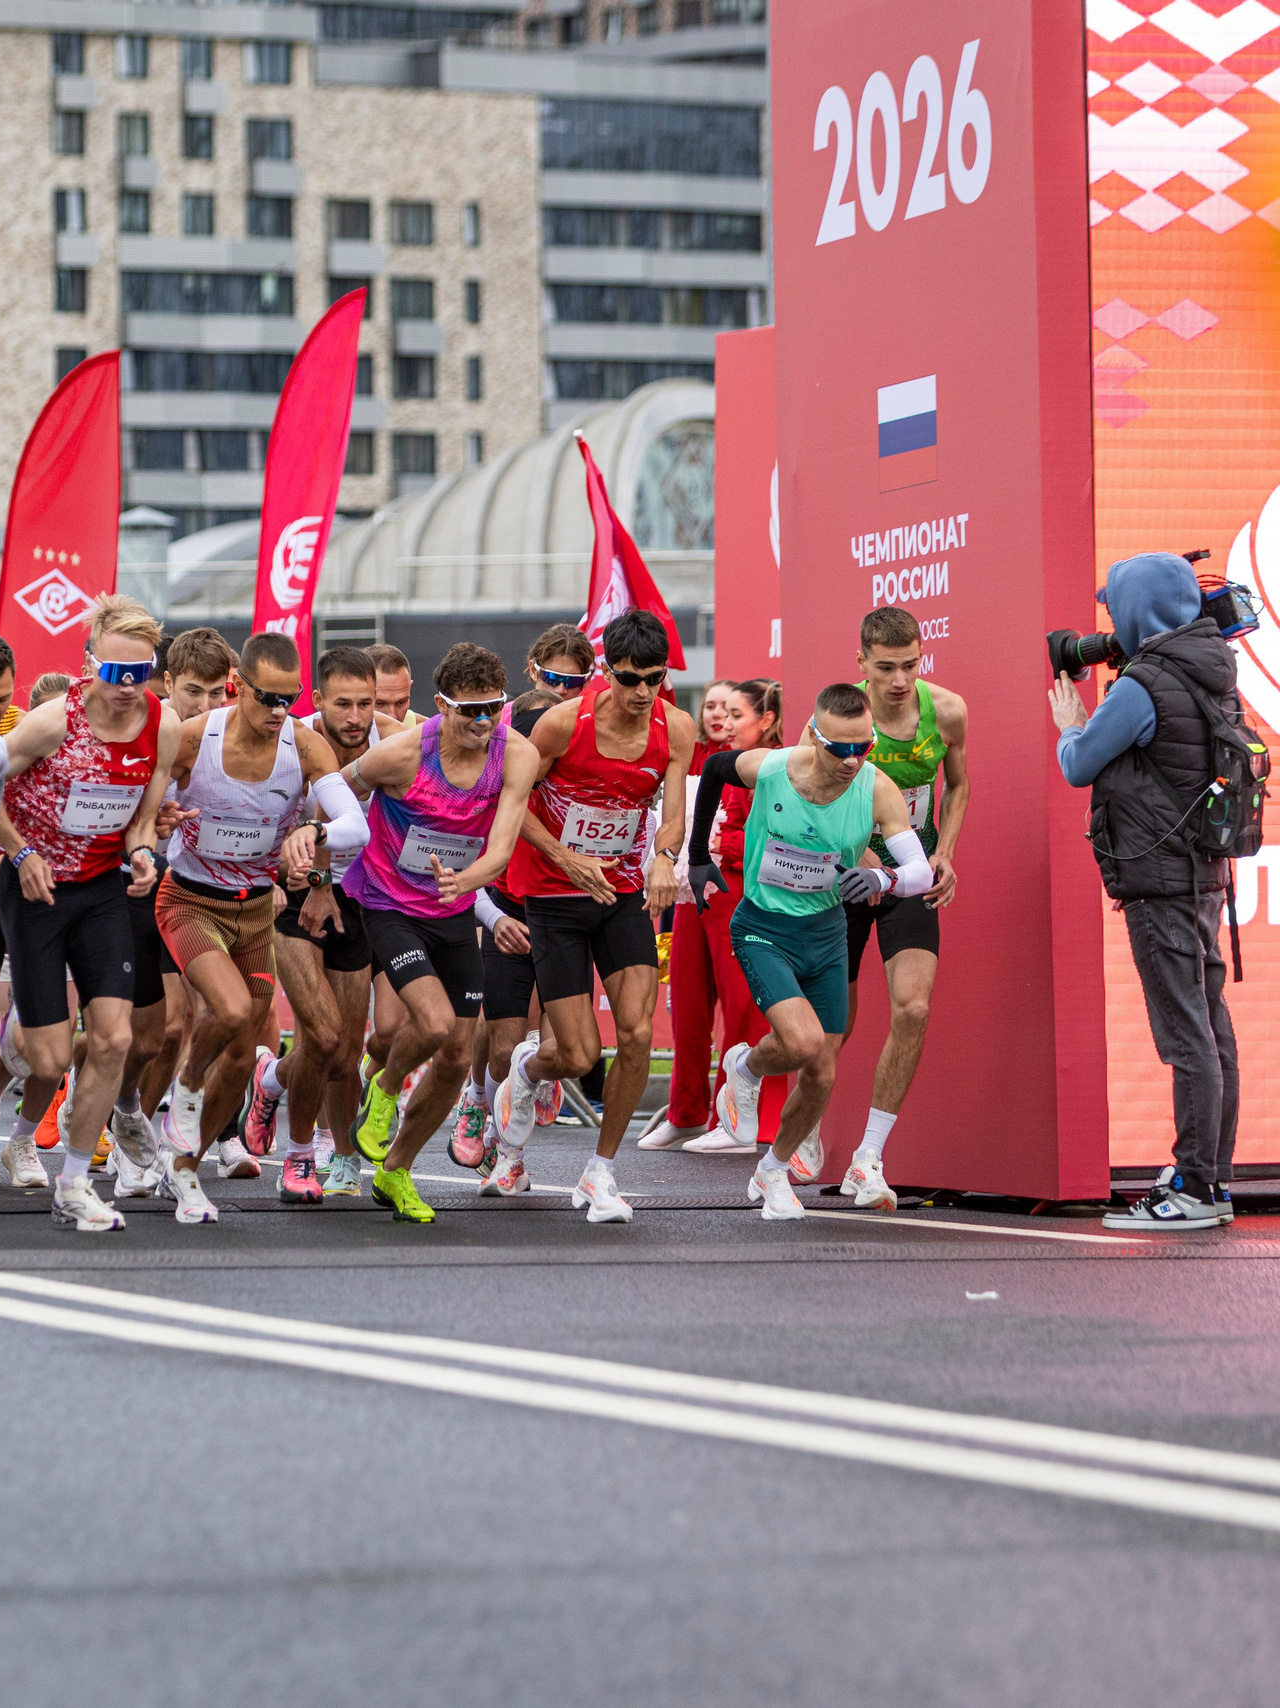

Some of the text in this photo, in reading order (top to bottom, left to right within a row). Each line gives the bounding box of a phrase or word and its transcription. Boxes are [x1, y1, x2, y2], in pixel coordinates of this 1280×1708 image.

[813, 38, 992, 247] 2026
[851, 513, 969, 568] ЧЕМПИОНАТ
[872, 561, 949, 607] РОССИИ
[919, 617, 950, 641] ОССЕ
[867, 747, 934, 763] DUCKS
[76, 801, 131, 810] РЫБАЛКИН
[216, 829, 260, 839] ГУРЖИЙ
[576, 819, 629, 840] 1524
[417, 845, 466, 857] НЕДЕЛИН
[774, 859, 824, 874] НИКИТИН
[390, 949, 424, 966] HUAWEI
[393, 956, 417, 971] WATCH
